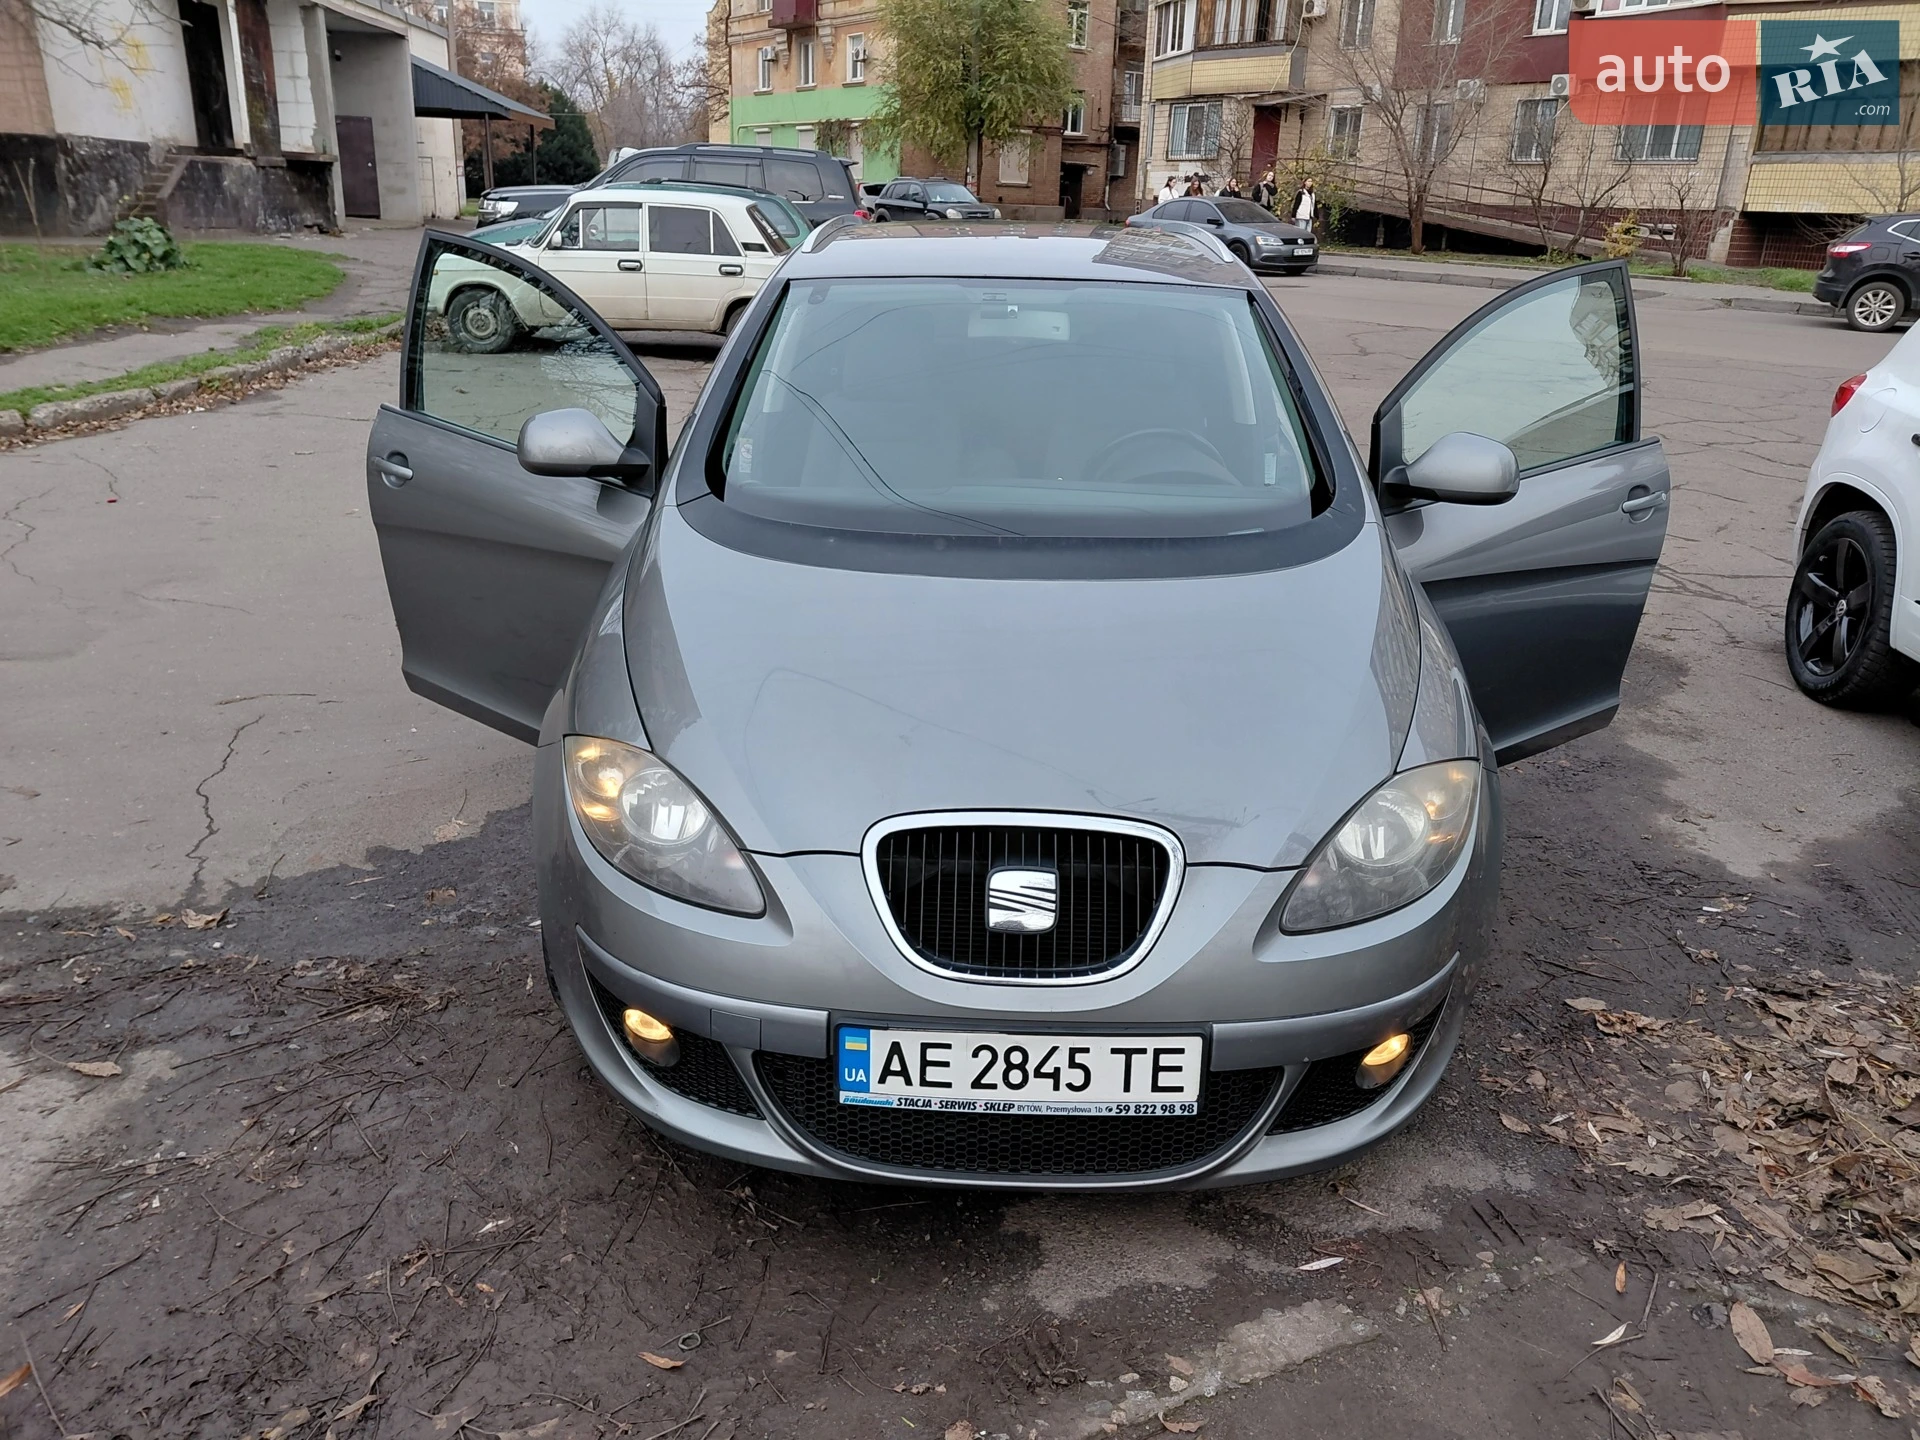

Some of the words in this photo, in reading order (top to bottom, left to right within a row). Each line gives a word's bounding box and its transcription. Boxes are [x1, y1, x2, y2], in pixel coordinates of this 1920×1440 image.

[844, 1068, 867, 1083] UA
[877, 1040, 953, 1089] AE
[970, 1044, 1092, 1092] 2845
[1110, 1047, 1186, 1093] TE
[896, 1097, 932, 1109] STACJA
[938, 1099, 978, 1111] SERWIS
[982, 1101, 1015, 1112] SKLEP
[1114, 1104, 1131, 1115] 59
[1133, 1104, 1157, 1115] 822
[1160, 1103, 1176, 1115] 98
[1179, 1103, 1195, 1115] 98
